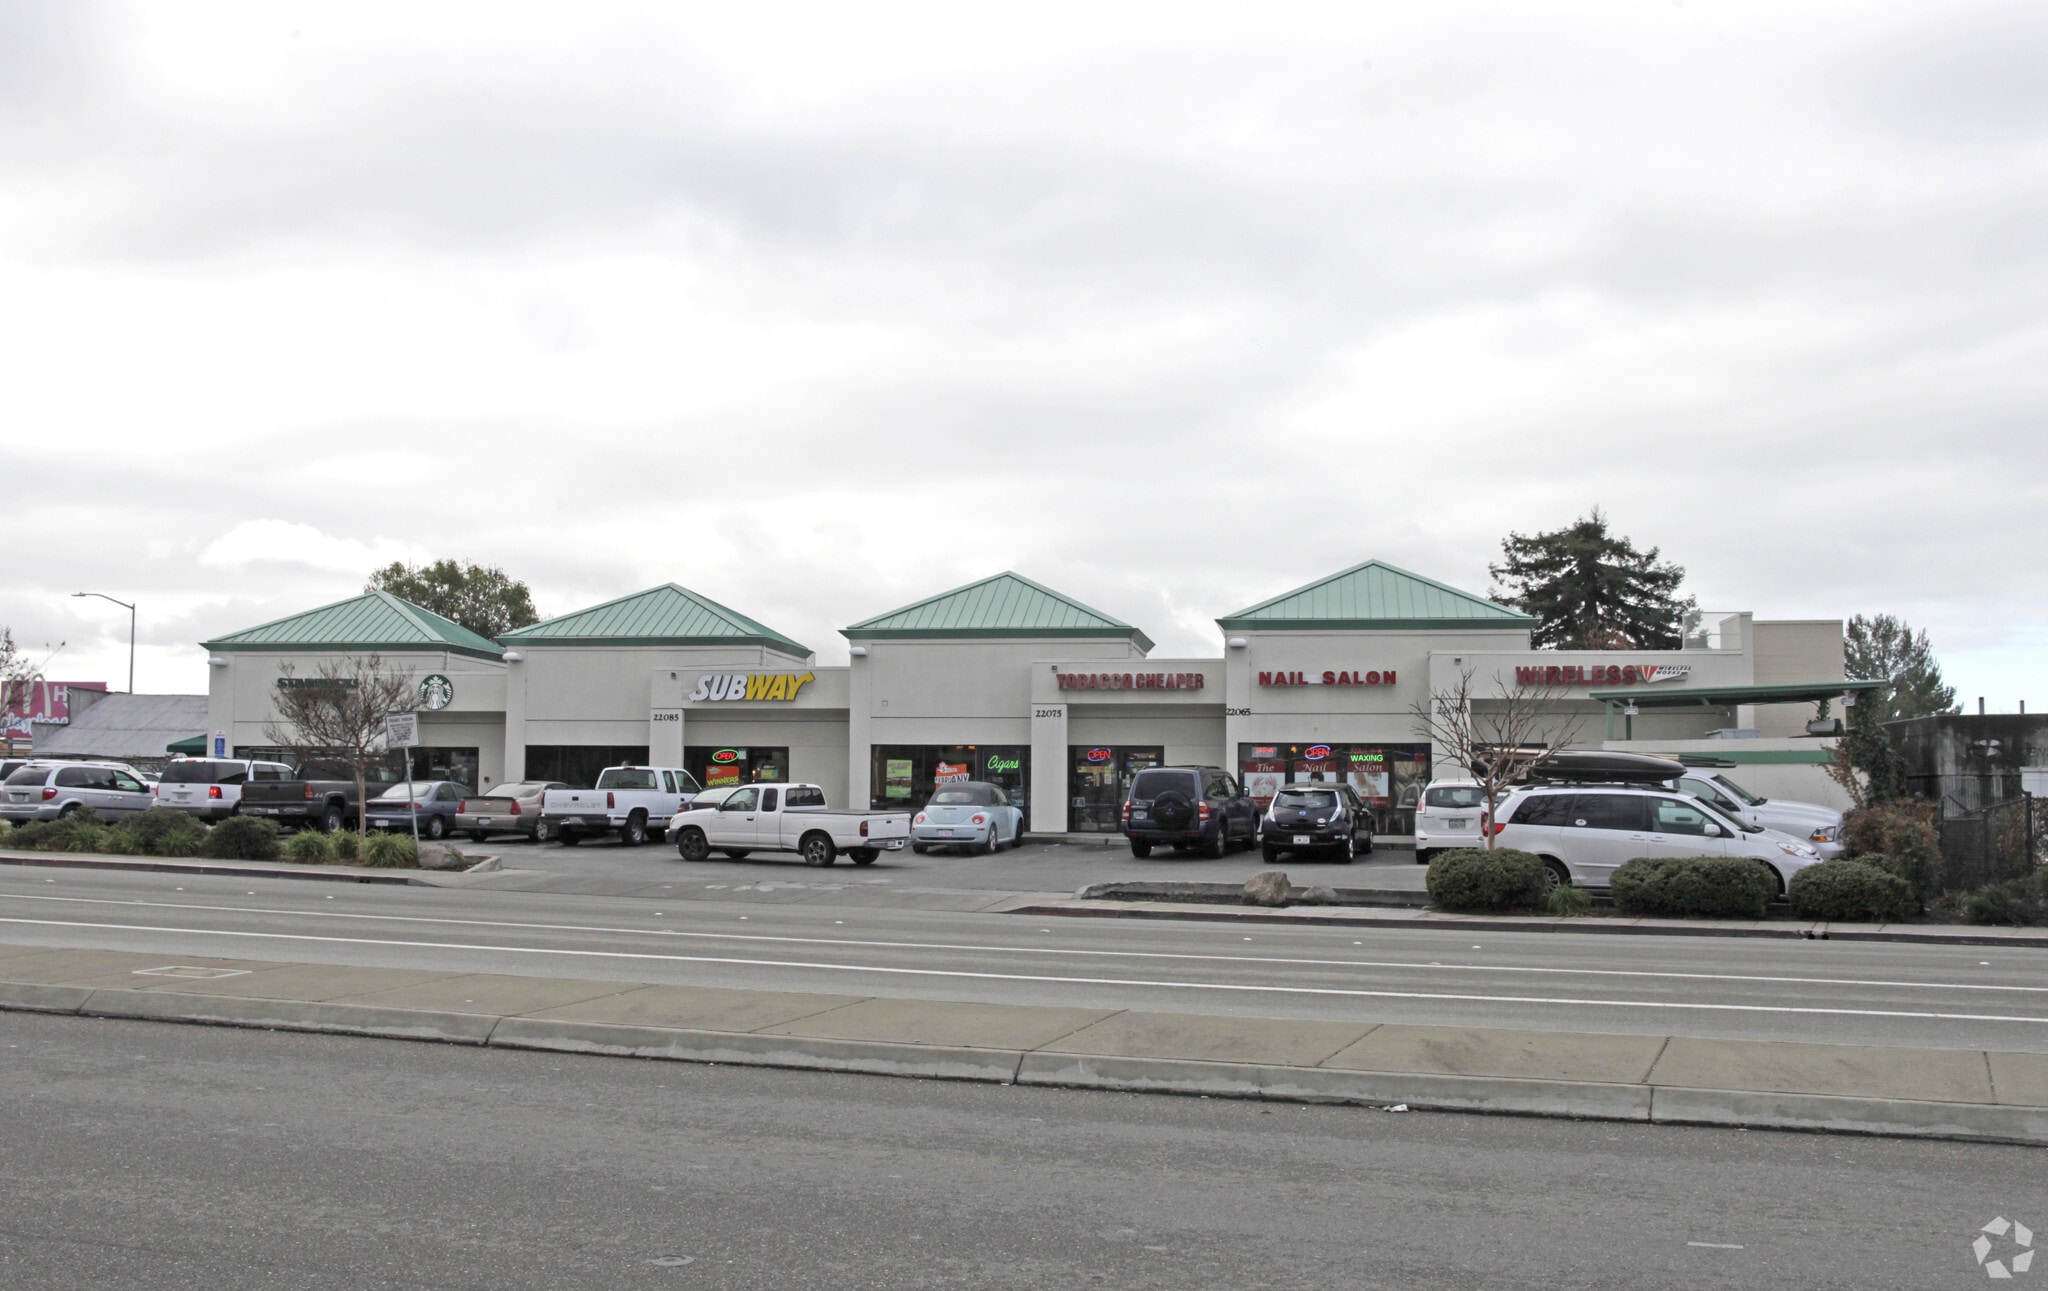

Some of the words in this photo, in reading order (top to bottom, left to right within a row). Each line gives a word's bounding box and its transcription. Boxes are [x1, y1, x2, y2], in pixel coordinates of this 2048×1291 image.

[1258, 671, 1309, 686] NAIL
[1322, 670, 1397, 687] SALON
[1515, 665, 1638, 686] WIRELESS
[1056, 673, 1133, 690] TOBACCO
[1135, 673, 1205, 690] CHEAPER
[689, 671, 816, 703] SUBWAY
[1035, 709, 1062, 718] 22075
[1226, 708, 1251, 716] 22065
[653, 713, 679, 722] 22085
[715, 751, 736, 760] OPEN
[1087, 750, 1112, 759] OPEN
[1304, 747, 1330, 757] OPEN
[1350, 754, 1384, 762] WAXING
[987, 754, 1019, 774] Cigars
[1255, 763, 1276, 772] The
[1302, 763, 1329, 773] Nail
[1353, 763, 1383, 772] Salon
[707, 775, 740, 787] WINNERS
